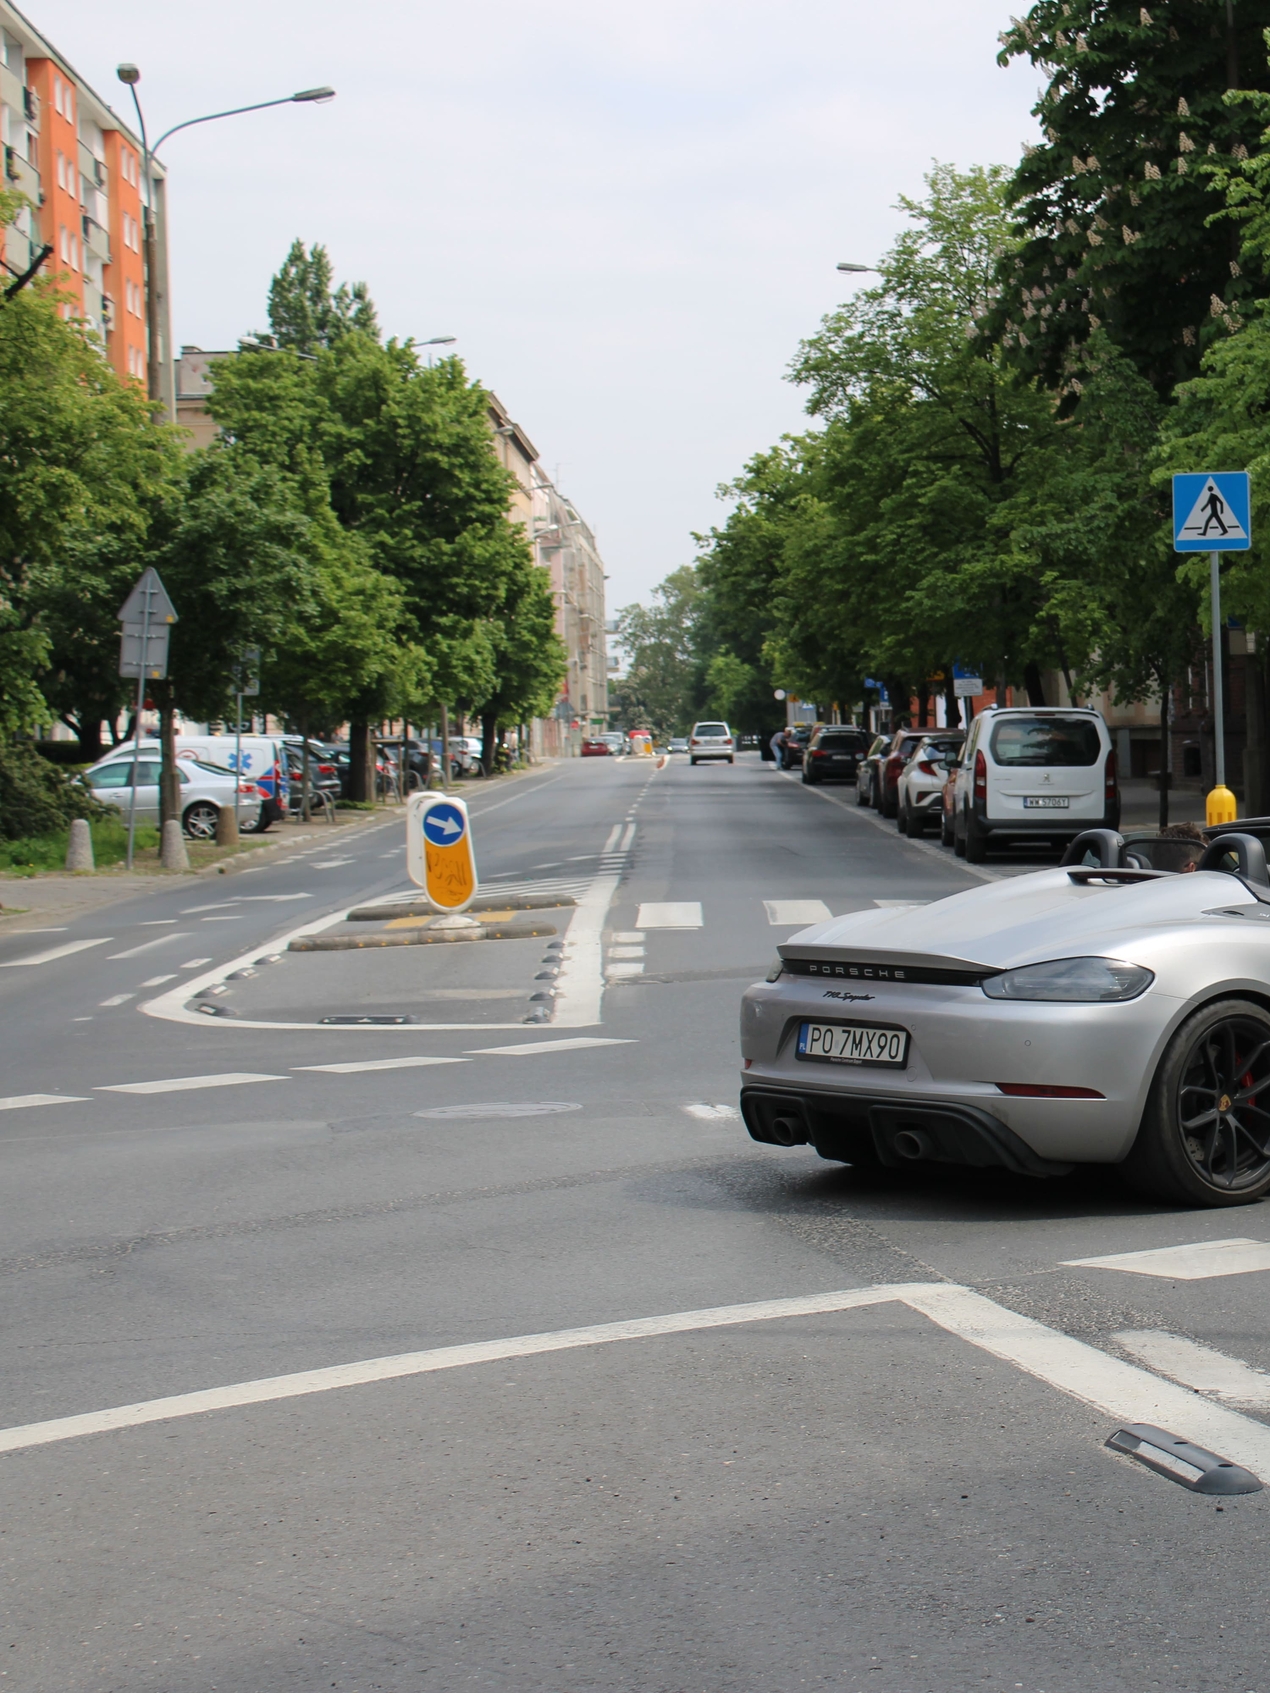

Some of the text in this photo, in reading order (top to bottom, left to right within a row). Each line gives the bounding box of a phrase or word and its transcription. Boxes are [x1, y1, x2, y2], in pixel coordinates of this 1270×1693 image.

[809, 965, 905, 978] PORSCHE
[809, 1027, 901, 1060] PO 7MX90
